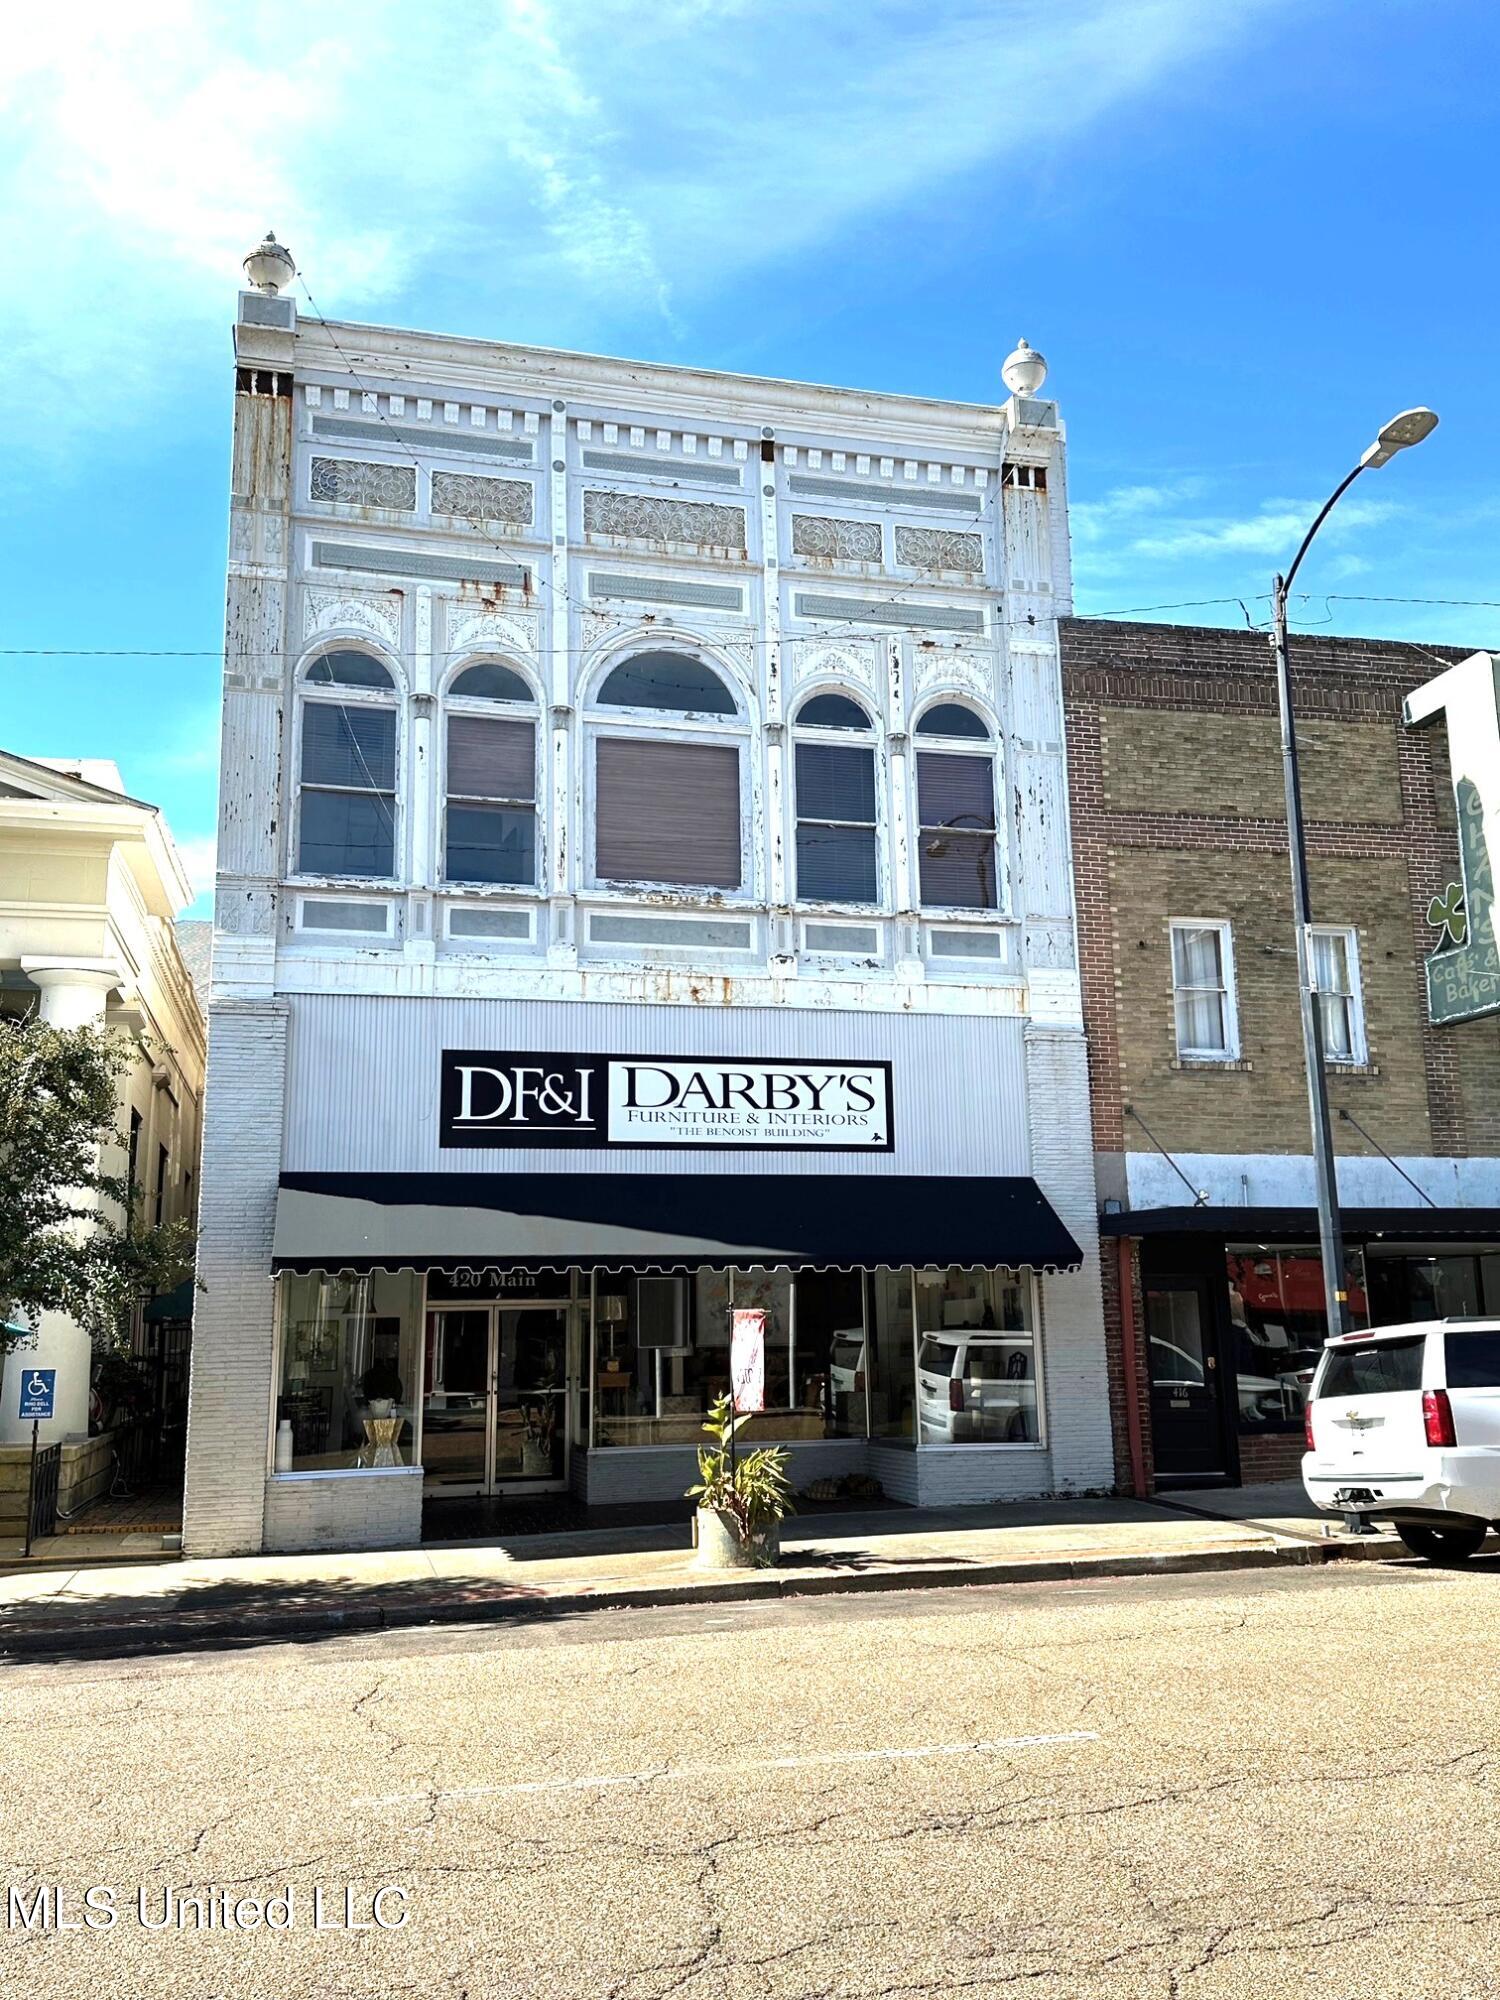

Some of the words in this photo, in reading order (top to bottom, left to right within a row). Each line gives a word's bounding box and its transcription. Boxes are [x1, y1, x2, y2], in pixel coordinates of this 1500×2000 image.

[453, 1066, 595, 1122] DF&I
[622, 1067, 876, 1112] DARBY'S
[627, 1110, 740, 1125] FURNITURE
[746, 1112, 760, 1124] &
[767, 1112, 869, 1126] INTERIORS
[670, 1127, 702, 1137] "THE
[706, 1127, 759, 1138] BENOIST
[764, 1128, 831, 1138] BUILDING"
[450, 1272, 481, 1287] 420
[490, 1272, 536, 1287] Main
